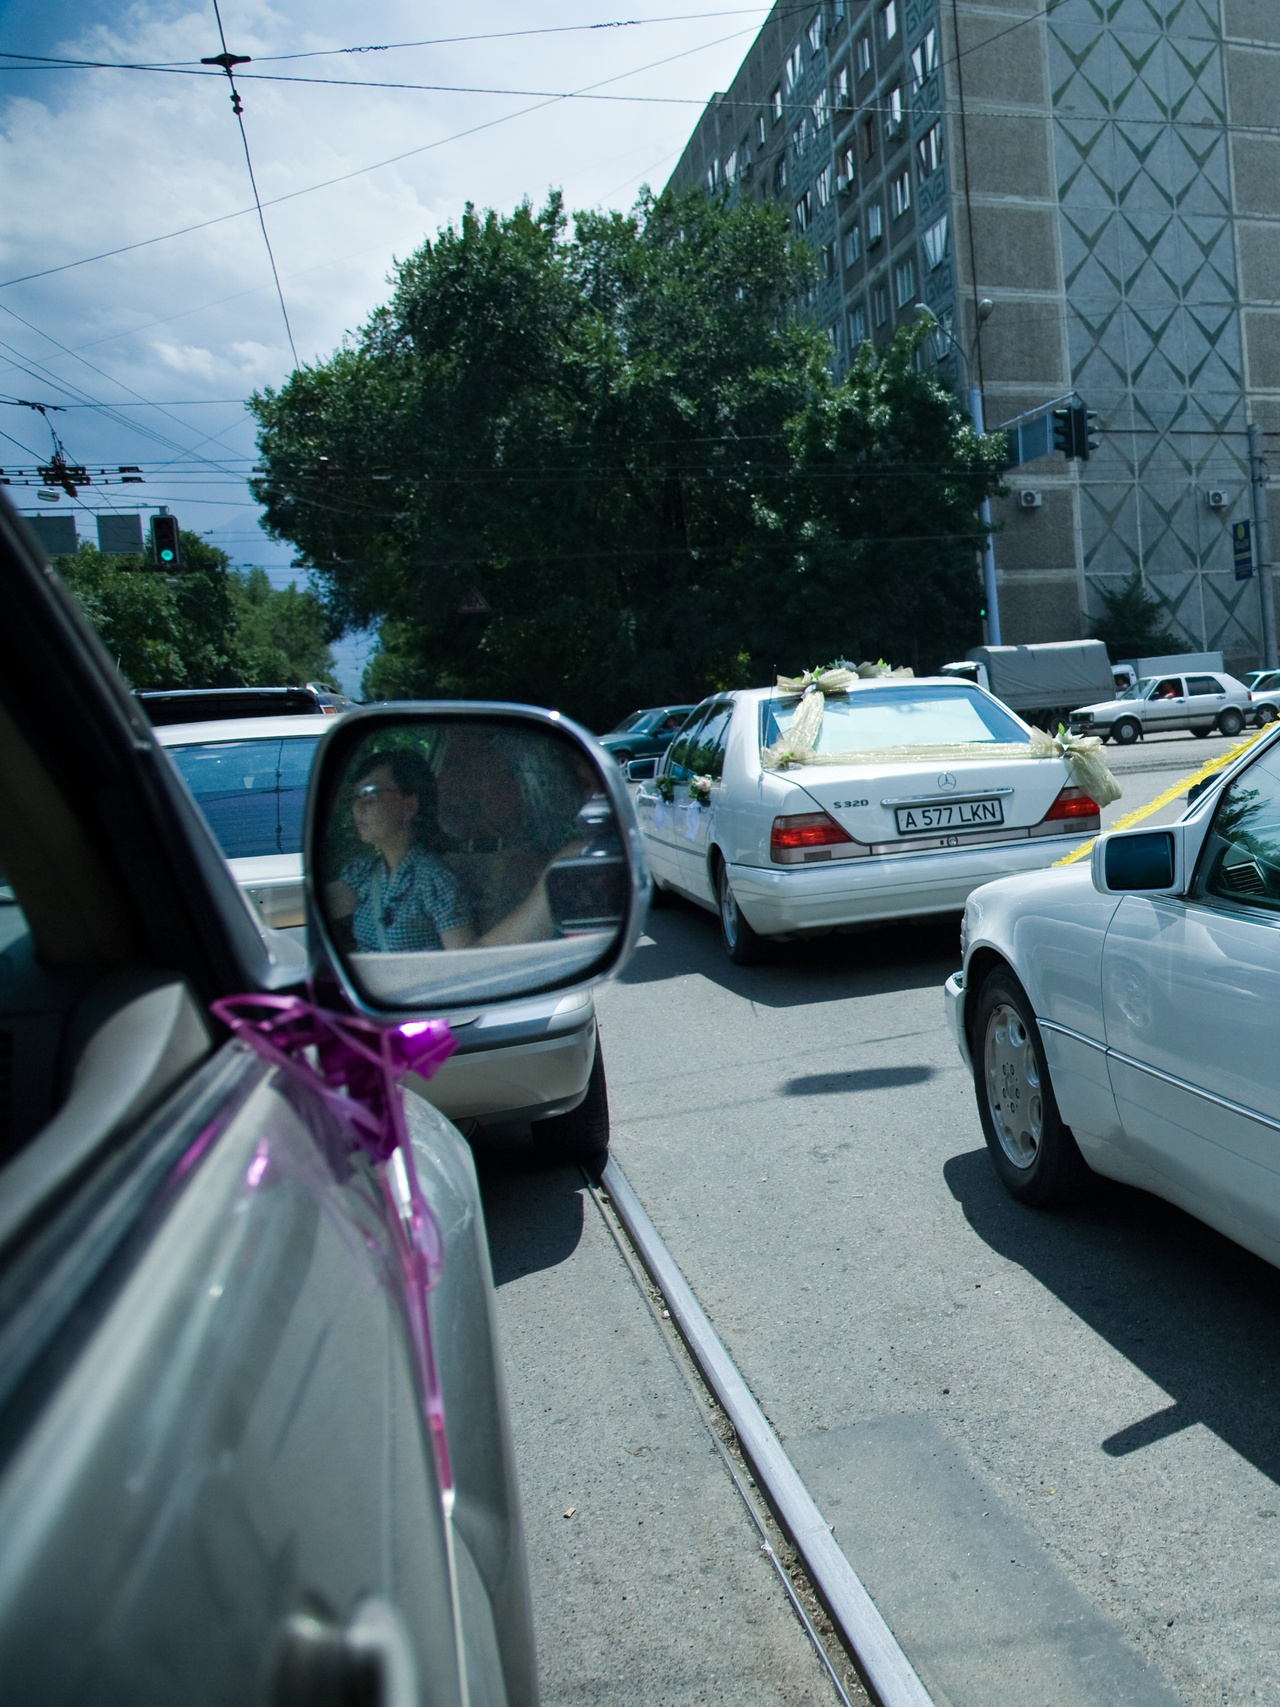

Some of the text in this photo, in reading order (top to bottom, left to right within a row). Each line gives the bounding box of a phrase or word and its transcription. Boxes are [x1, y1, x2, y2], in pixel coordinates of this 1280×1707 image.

[834, 799, 869, 809] S 320
[905, 803, 997, 828] A 577 LKN
